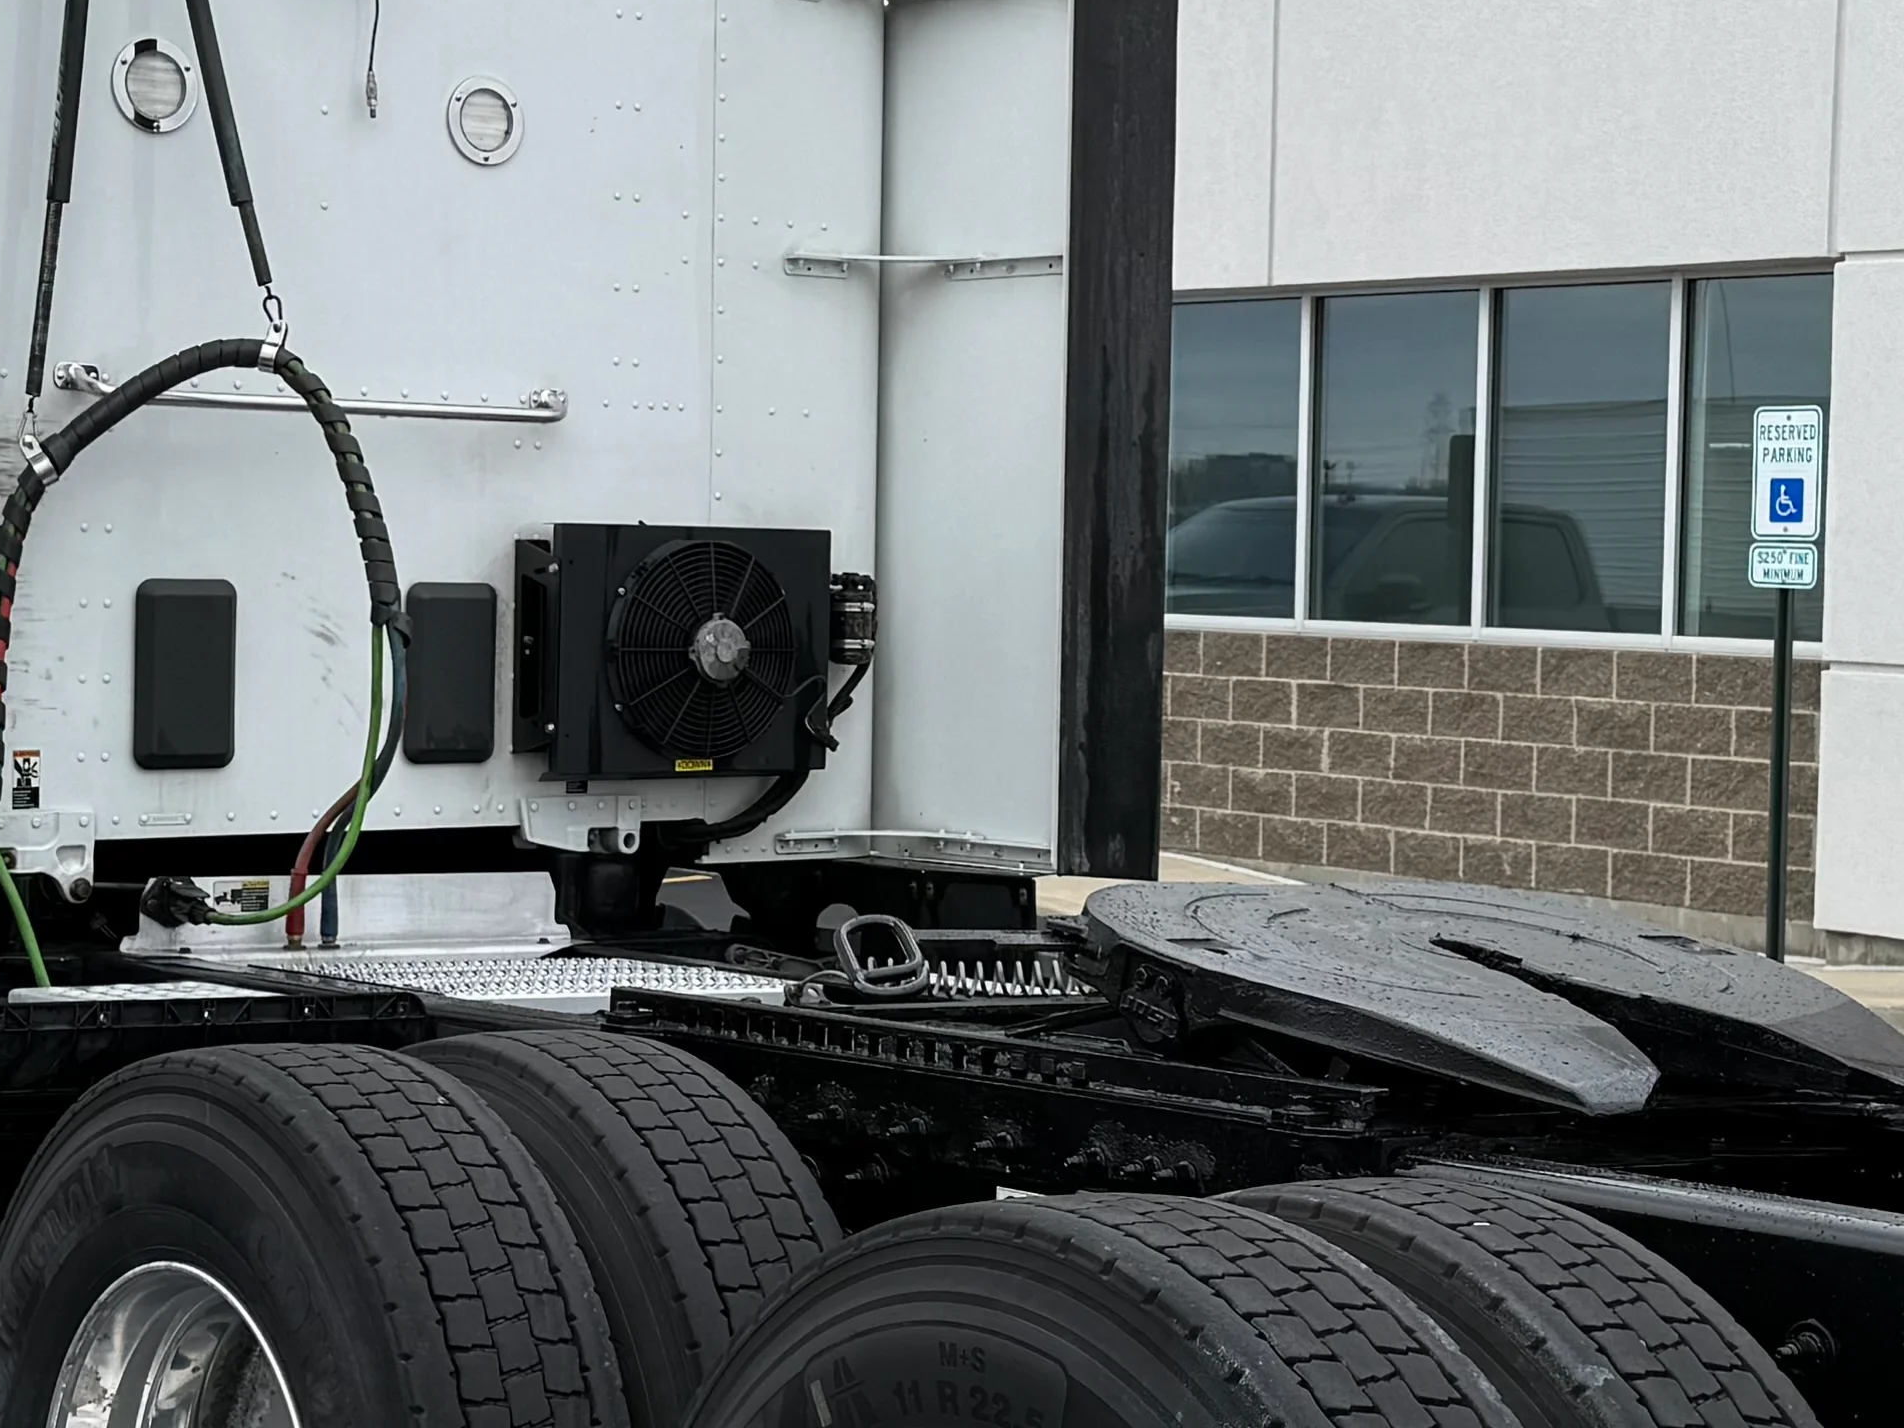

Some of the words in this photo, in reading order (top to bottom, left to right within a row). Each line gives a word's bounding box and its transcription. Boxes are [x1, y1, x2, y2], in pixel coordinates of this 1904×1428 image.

[1759, 424, 1816, 441] RESERVED
[1762, 447, 1813, 464] PARKING
[1757, 550, 1783, 564] $250
[1789, 551, 1809, 565] FINE
[1762, 568, 1804, 581] MINIMUM
[938, 1341, 986, 1373] M+S
[936, 1380, 960, 1417] R
